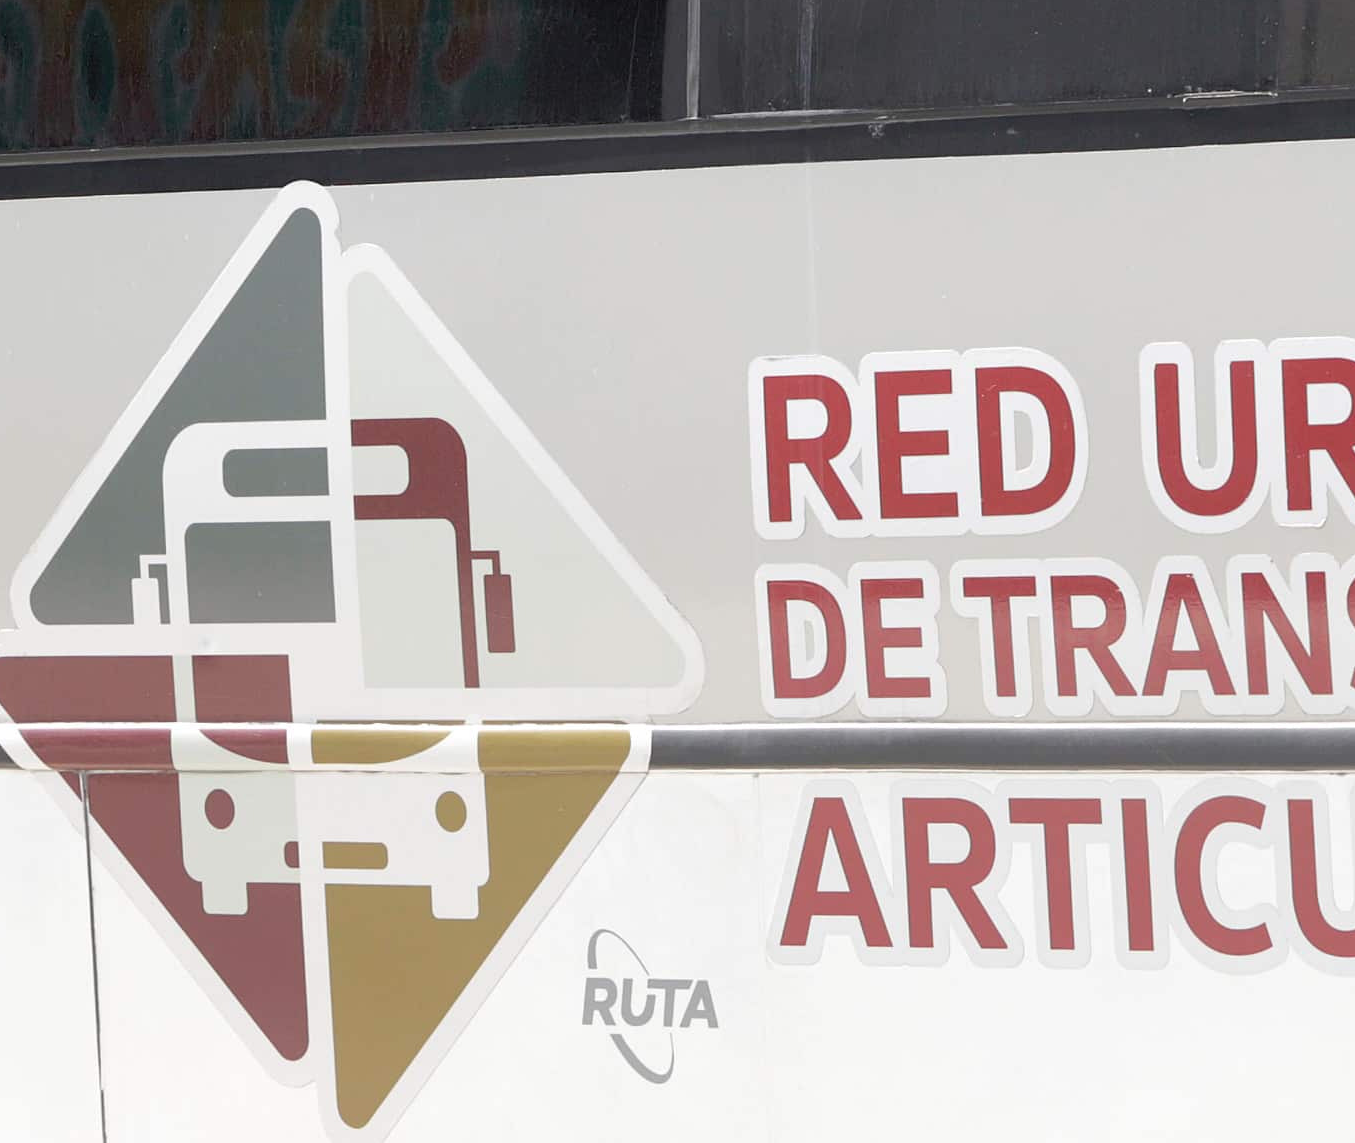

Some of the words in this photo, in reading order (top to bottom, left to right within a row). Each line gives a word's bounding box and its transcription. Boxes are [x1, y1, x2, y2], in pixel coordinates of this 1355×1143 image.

[765, 367, 1075, 522] RED
[769, 579, 930, 698] DE
[582, 978, 718, 1028] RUTA
